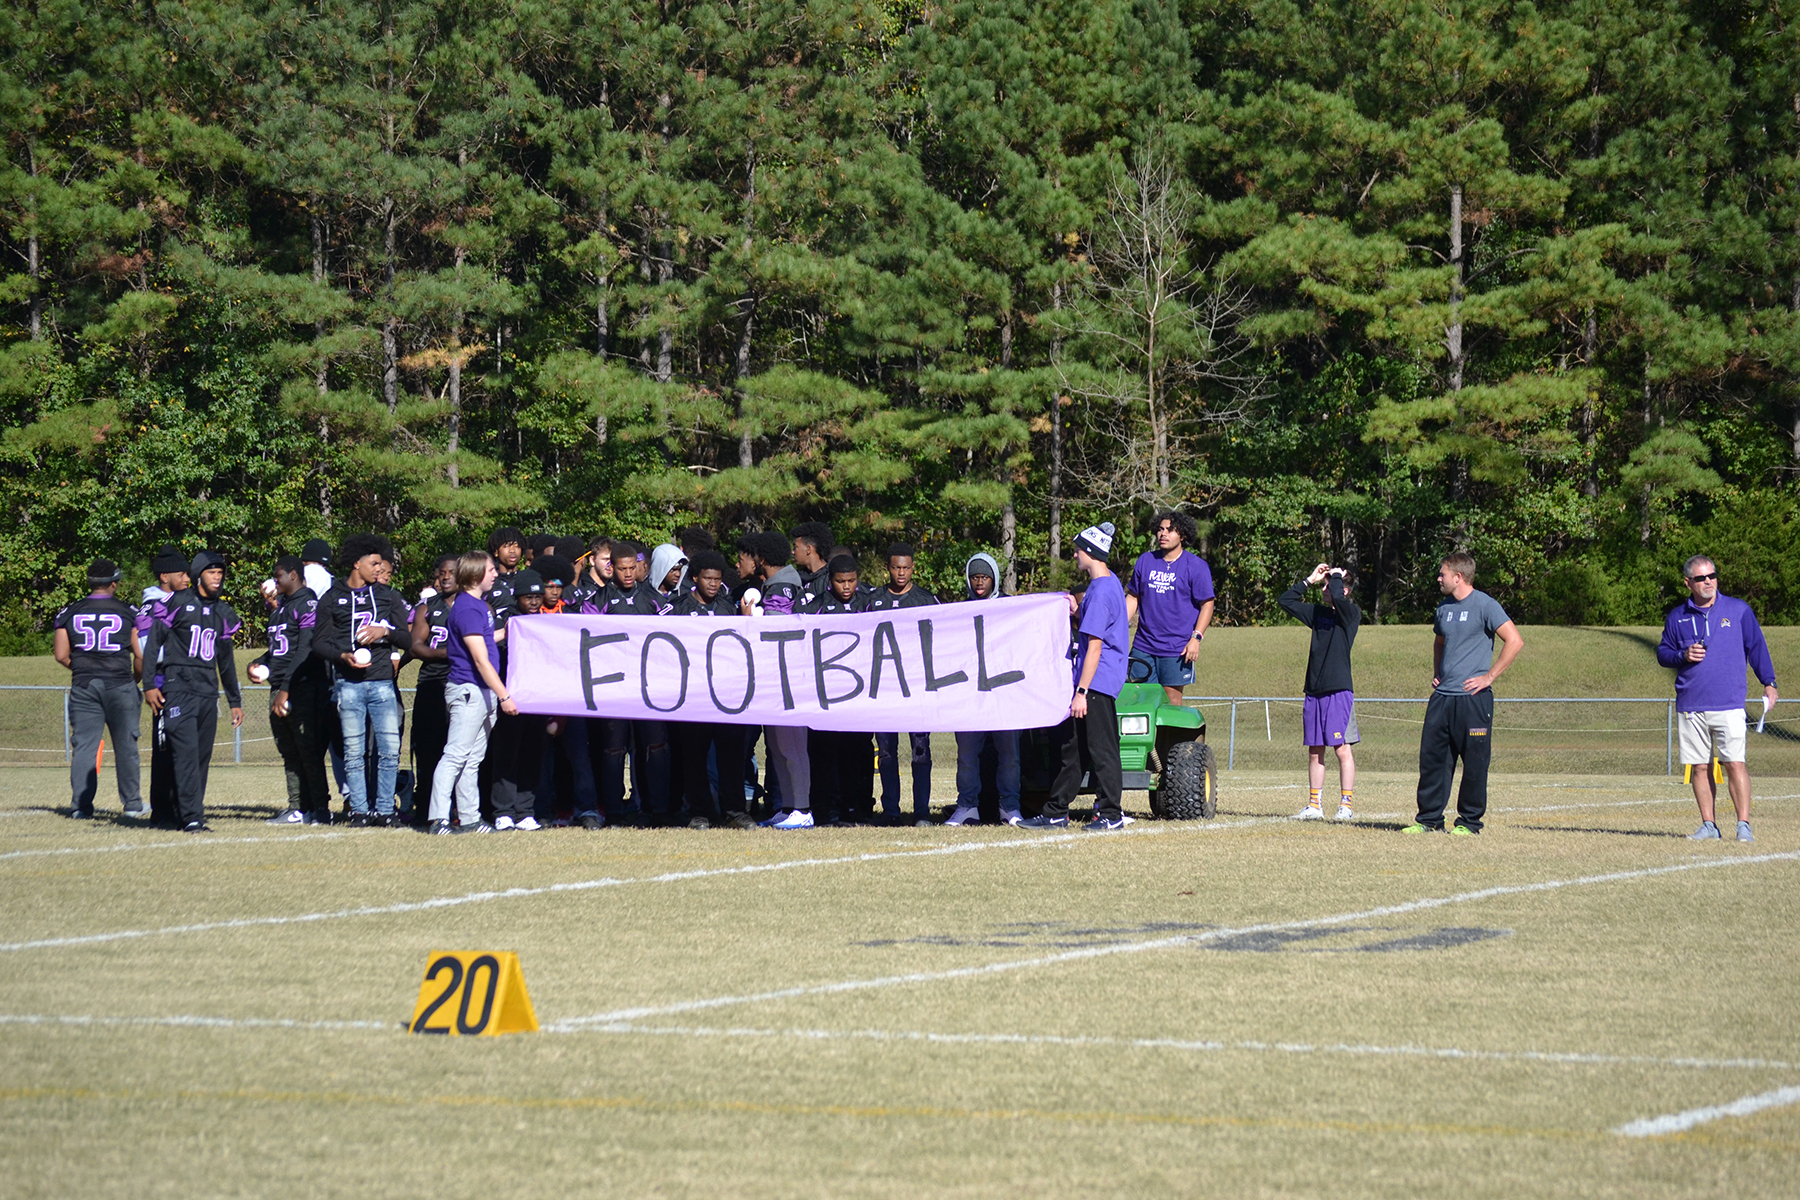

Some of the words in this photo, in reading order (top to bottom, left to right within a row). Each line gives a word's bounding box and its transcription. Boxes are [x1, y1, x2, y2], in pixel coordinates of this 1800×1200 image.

[73, 614, 122, 651] 52
[189, 624, 217, 661] 10
[579, 615, 1026, 716] FOOTBALL
[413, 954, 500, 1035] 20
